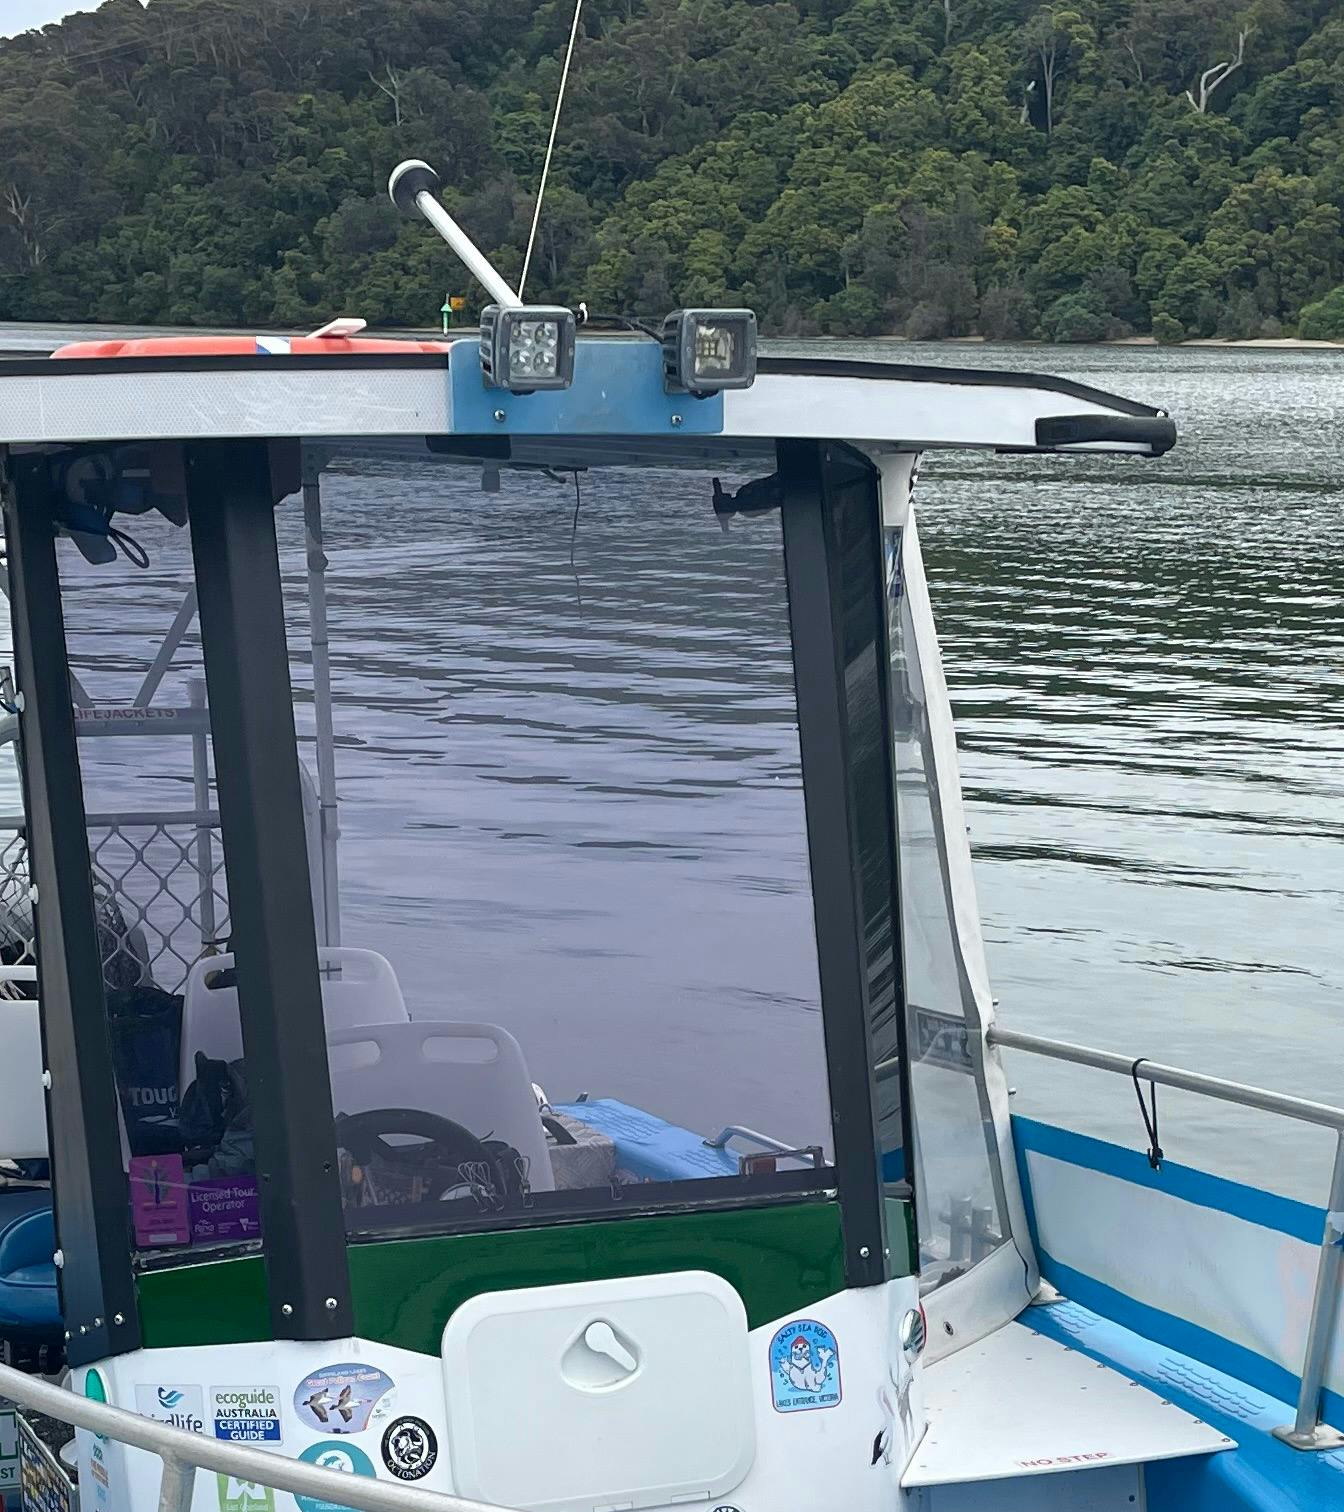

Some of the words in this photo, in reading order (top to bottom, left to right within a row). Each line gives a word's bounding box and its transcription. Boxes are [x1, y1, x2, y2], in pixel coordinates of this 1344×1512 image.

[73, 708, 175, 720] LIFEJACKETS
[191, 1189, 231, 1202] Licensed
[232, 1187, 255, 1198] Tour
[202, 1199, 245, 1213] Operator
[798, 1323, 812, 1333] SEA
[215, 1389, 275, 1408] ecoguide
[216, 1408, 277, 1418] AUSTRALIA
[219, 1420, 275, 1430] CERTIFIED
[230, 1431, 265, 1440] GUIDE
[387, 1451, 436, 1479] OCTONATION
[1019, 1458, 1053, 1469] NO
[1056, 1452, 1109, 1465] STEP
